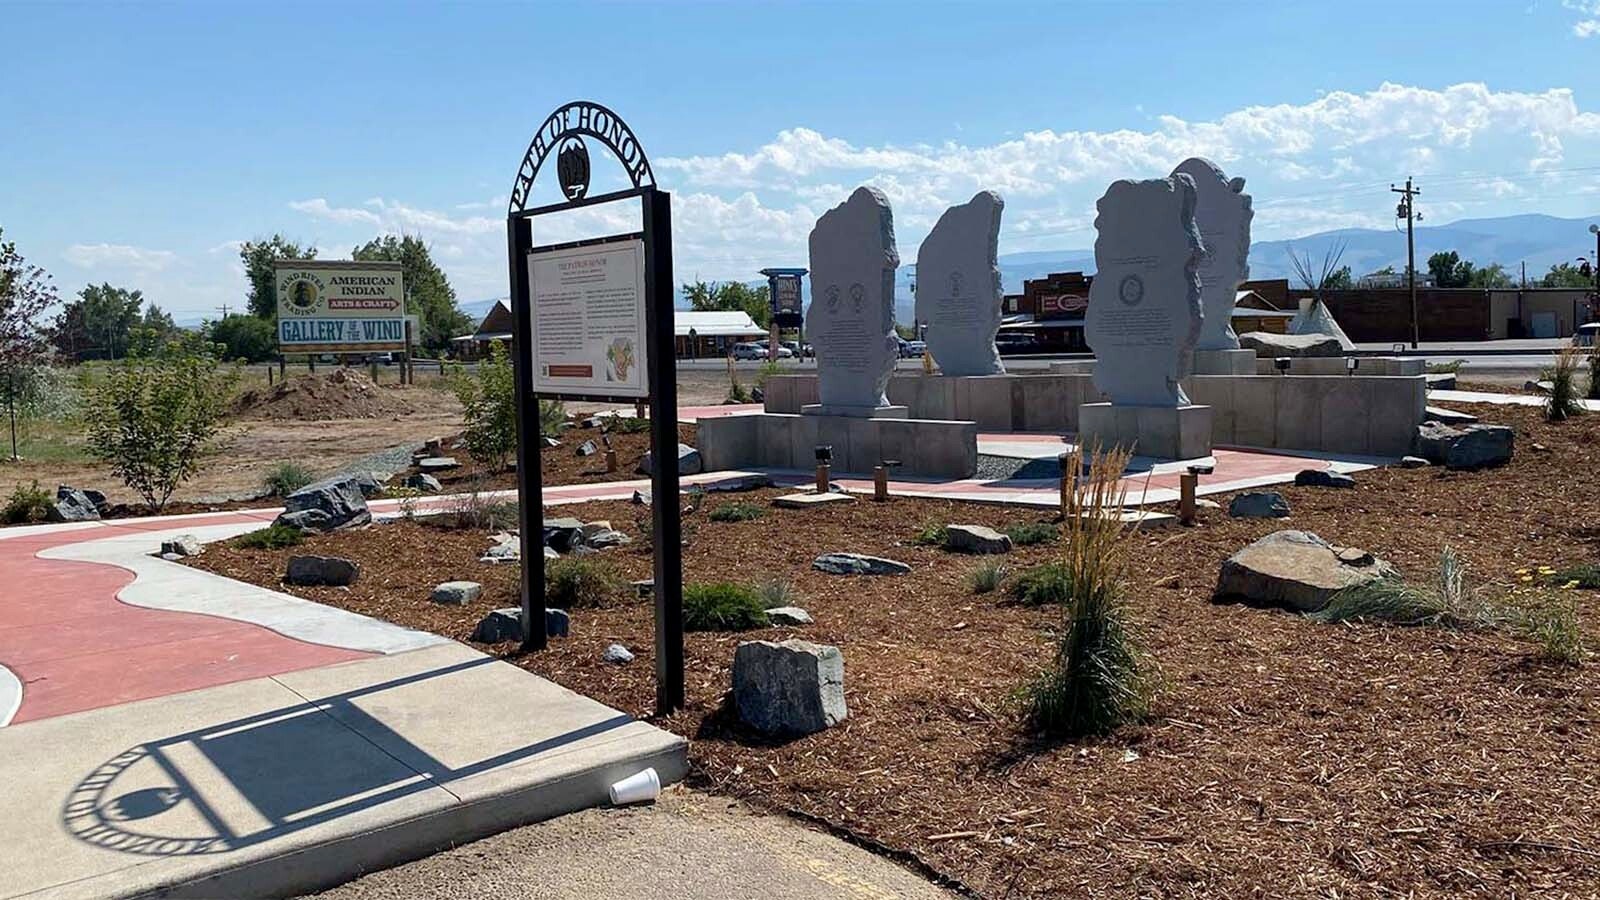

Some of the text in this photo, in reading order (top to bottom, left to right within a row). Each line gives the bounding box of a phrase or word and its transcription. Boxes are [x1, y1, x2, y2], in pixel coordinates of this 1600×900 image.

[511, 104, 650, 209] PATH OF HONOR
[280, 272, 325, 291] WIND RIVER
[330, 276, 396, 285] AMERICAN
[341, 286, 385, 295] INDIAN
[330, 300, 396, 308] ARTS & CRAFTS
[281, 320, 344, 341] GALLERY
[362, 320, 401, 341] WIND
